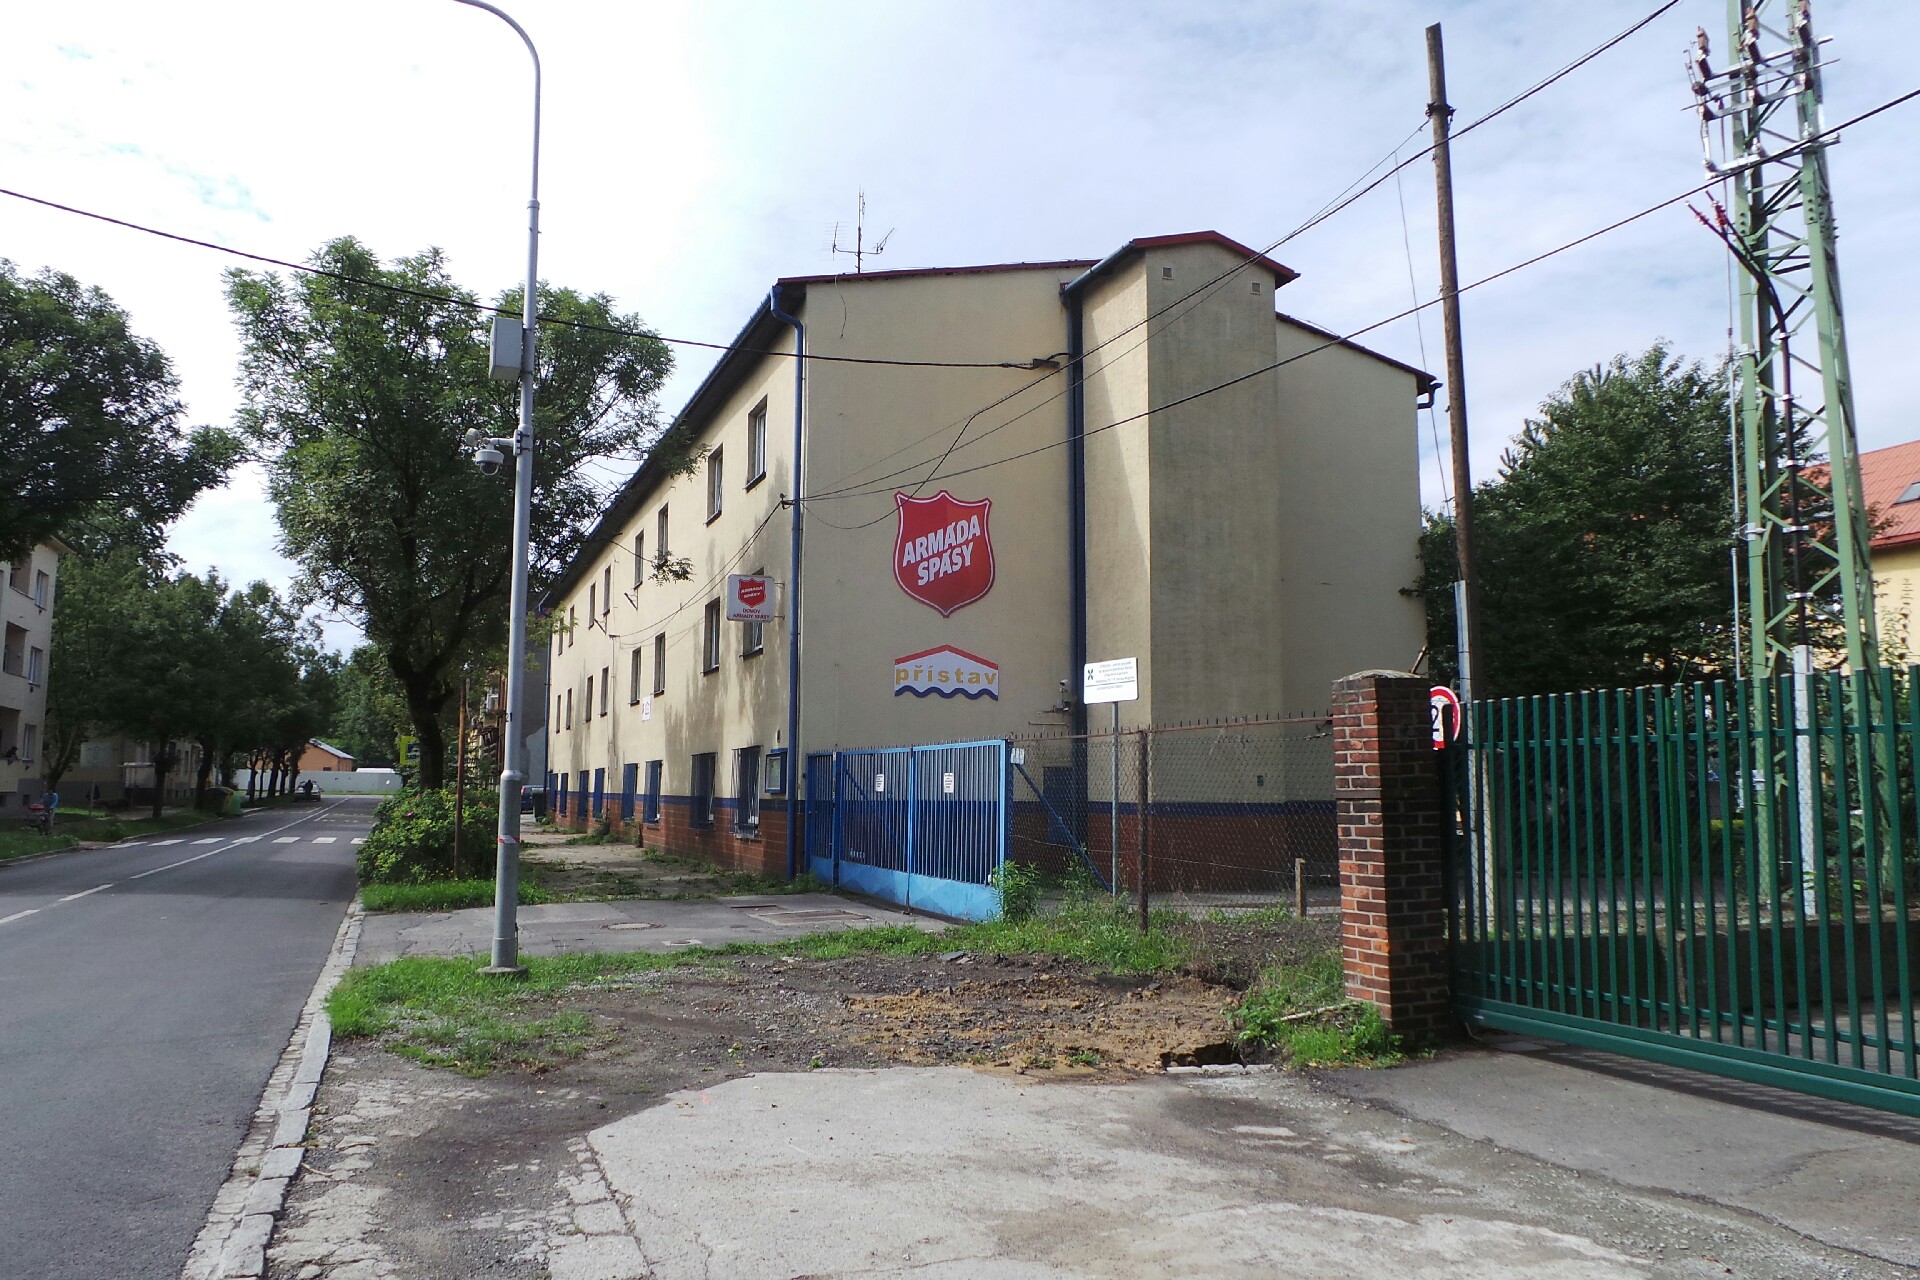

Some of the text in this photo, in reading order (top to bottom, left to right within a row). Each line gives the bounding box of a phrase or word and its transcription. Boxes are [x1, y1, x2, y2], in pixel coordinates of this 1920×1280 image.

[903, 515, 980, 567] ARMÁDA
[918, 542, 974, 586] SPÁSY
[895, 664, 997, 685] přístav
